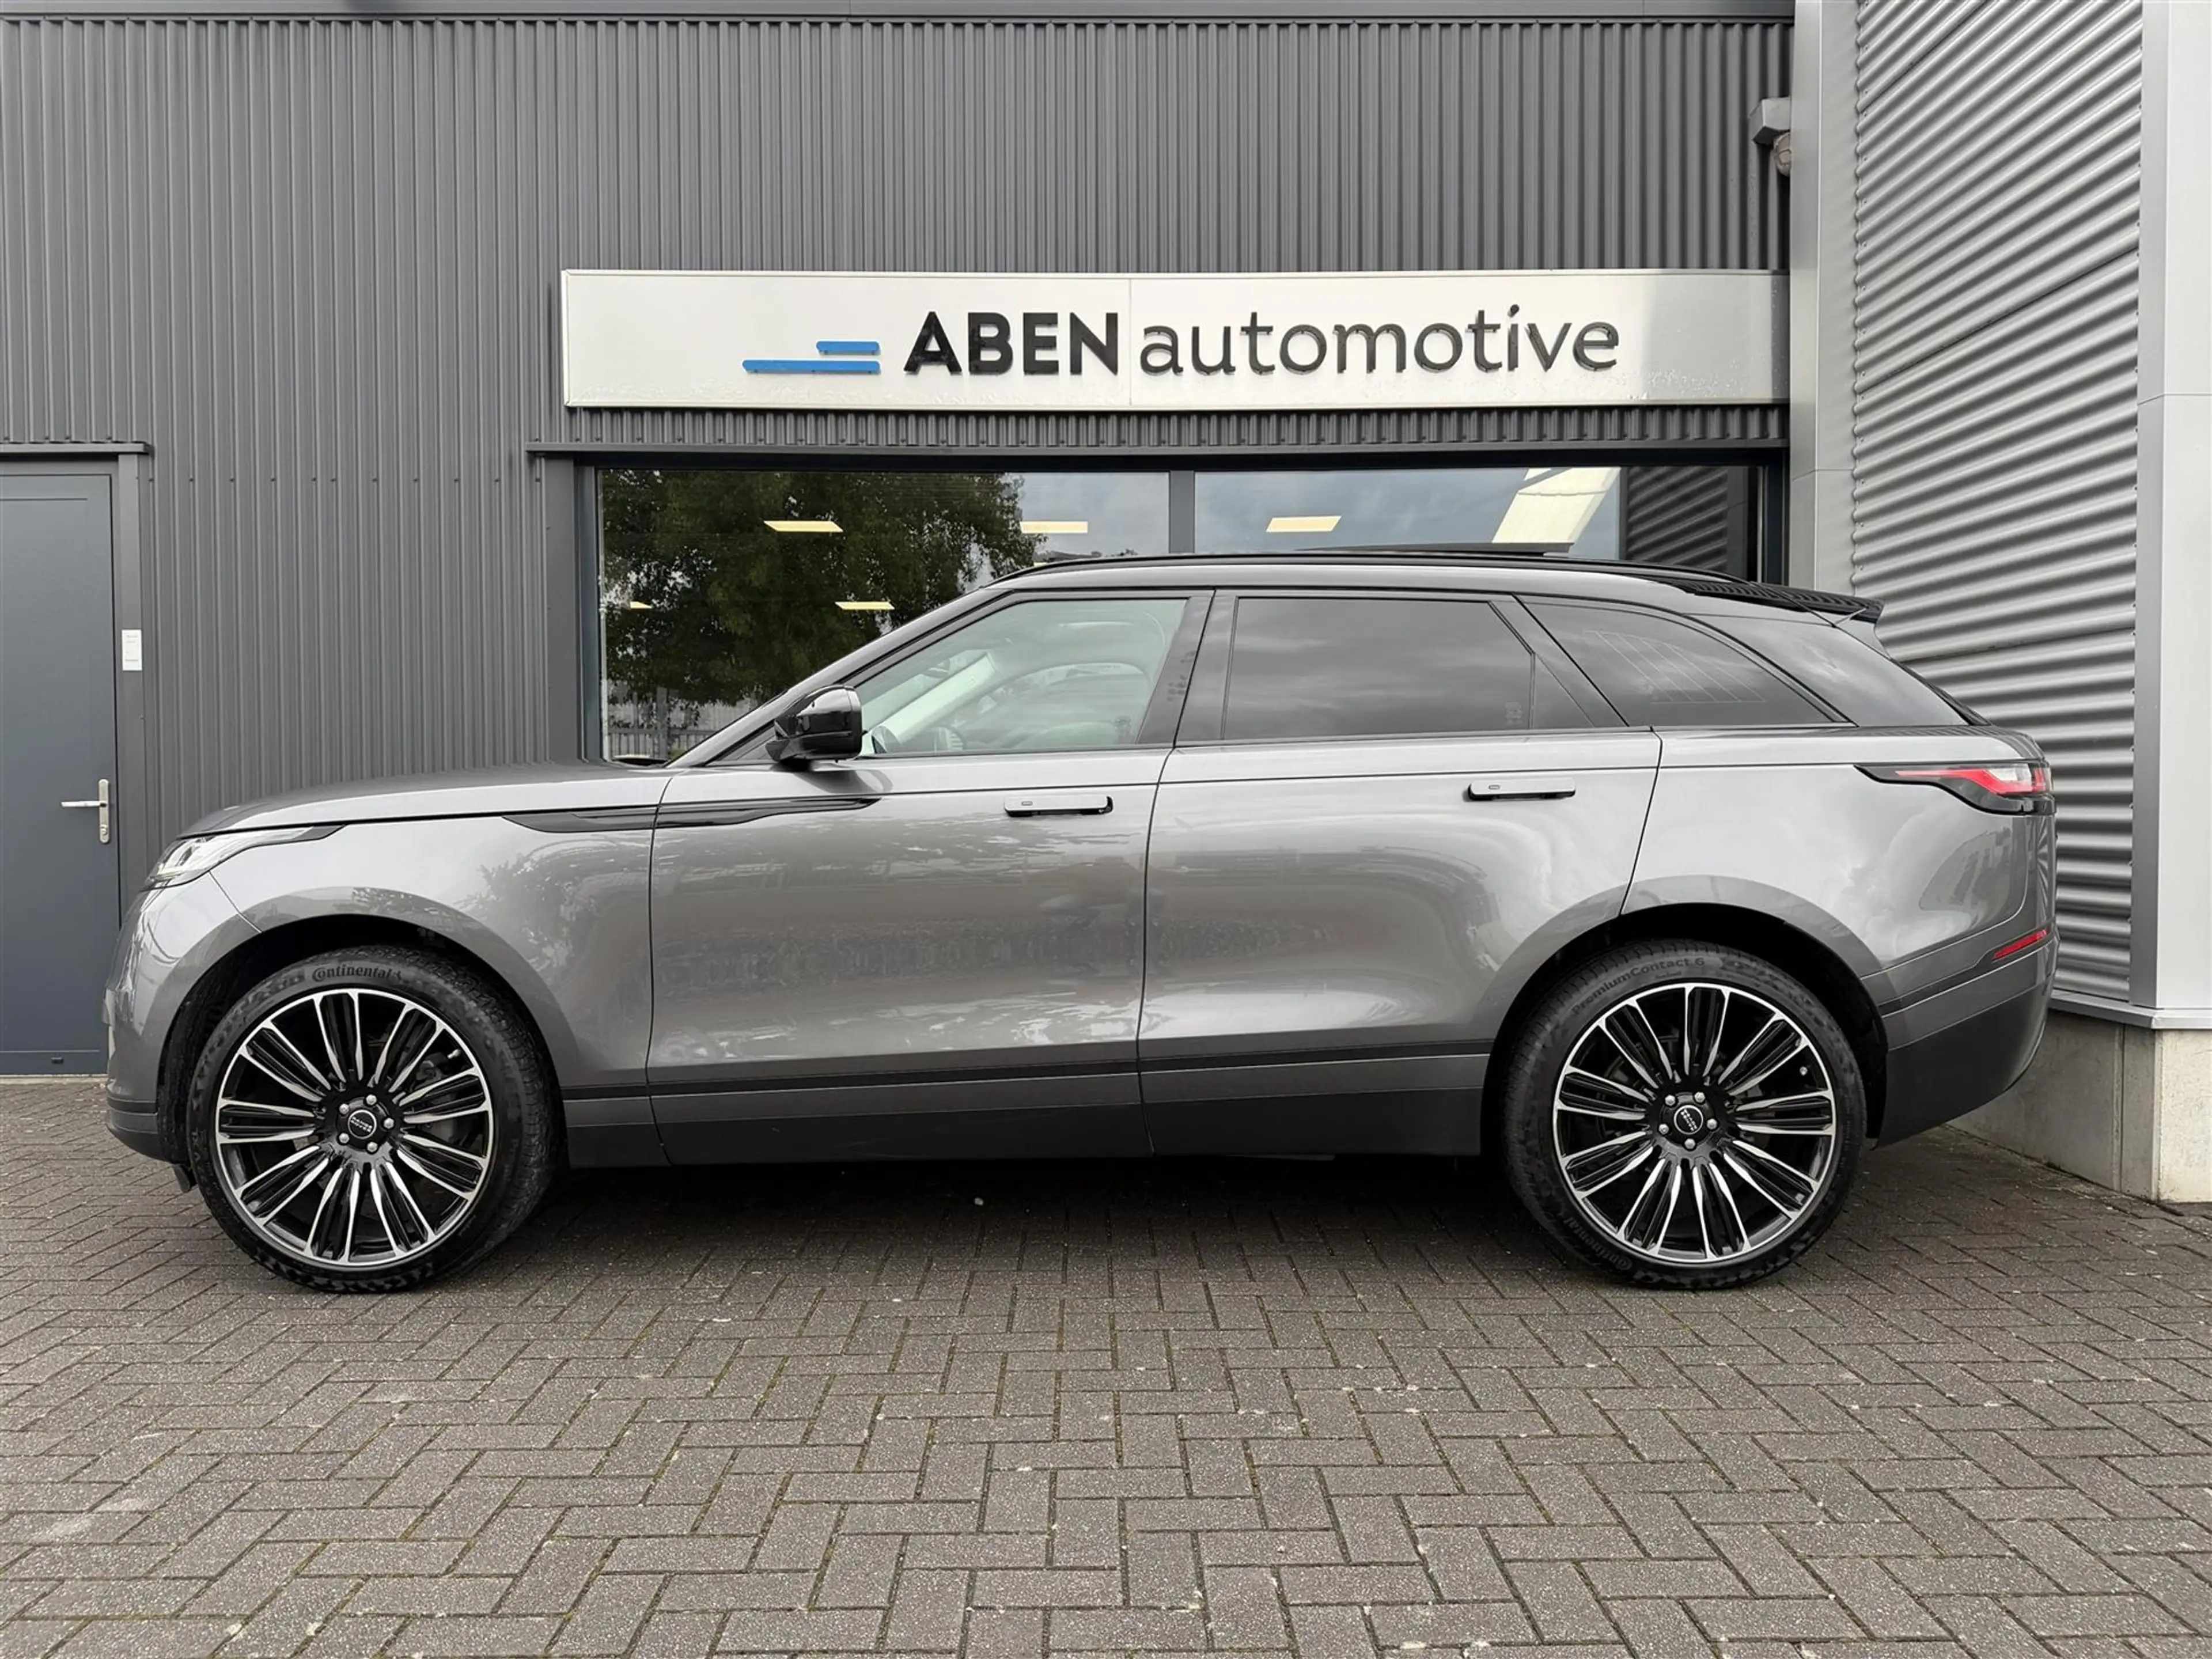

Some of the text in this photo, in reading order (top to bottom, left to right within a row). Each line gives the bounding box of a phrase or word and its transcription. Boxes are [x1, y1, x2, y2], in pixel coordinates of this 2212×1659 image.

[903, 304, 1620, 376] ABEN automotive
[312, 964, 393, 982] Continental
[1571, 957, 1705, 1015] PremiumContact 6
